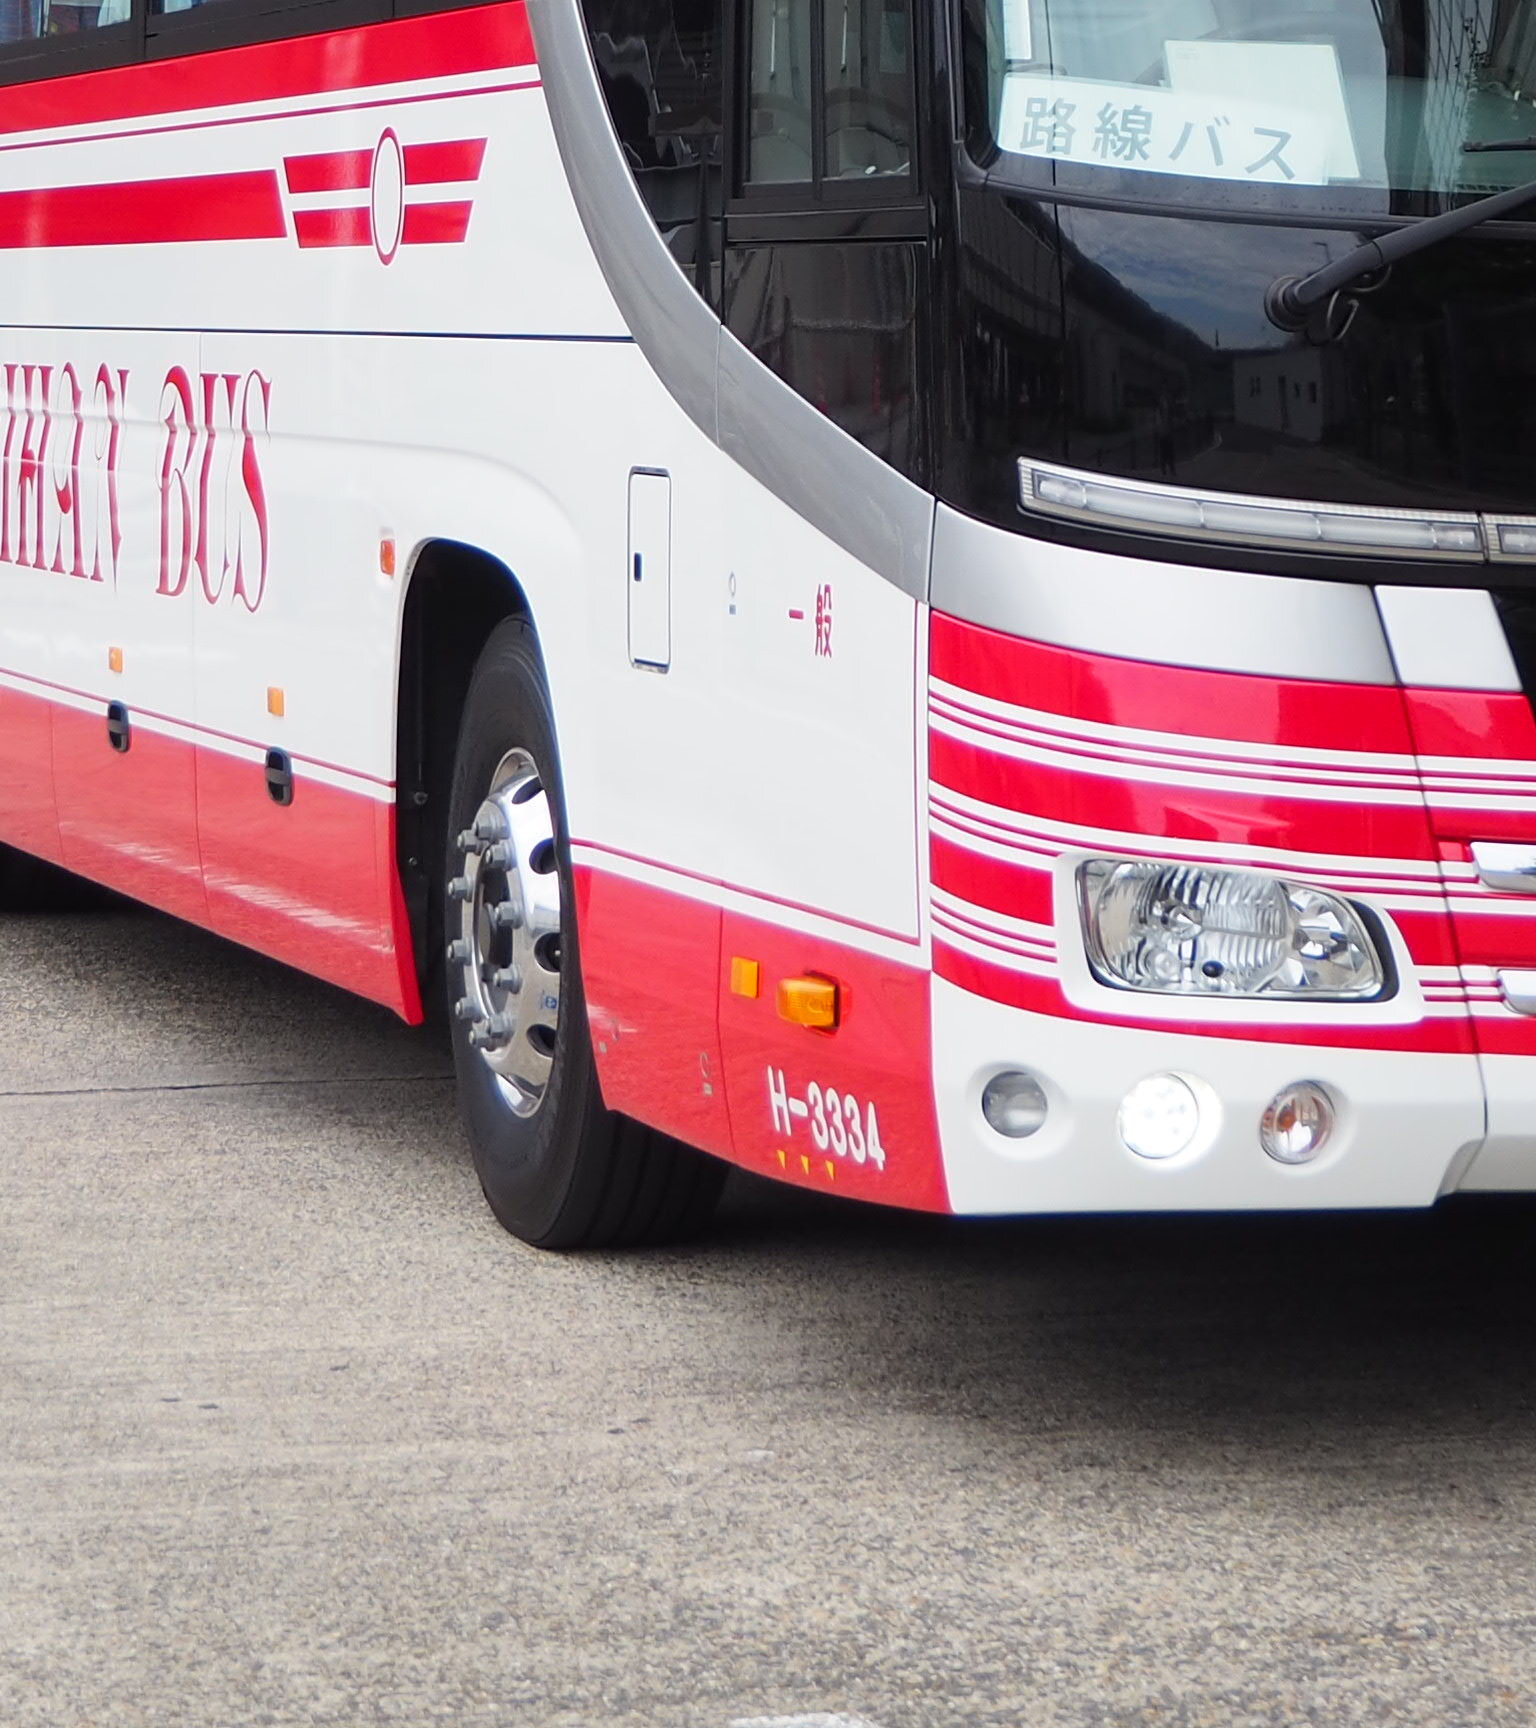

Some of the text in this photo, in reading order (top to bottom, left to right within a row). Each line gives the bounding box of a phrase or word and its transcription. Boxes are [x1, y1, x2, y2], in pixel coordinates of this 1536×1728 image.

[1018, 95, 1296, 180] 路線バス
[156, 365, 272, 613] BUS
[788, 583, 832, 659] 一般
[767, 1065, 886, 1171] H-3334
